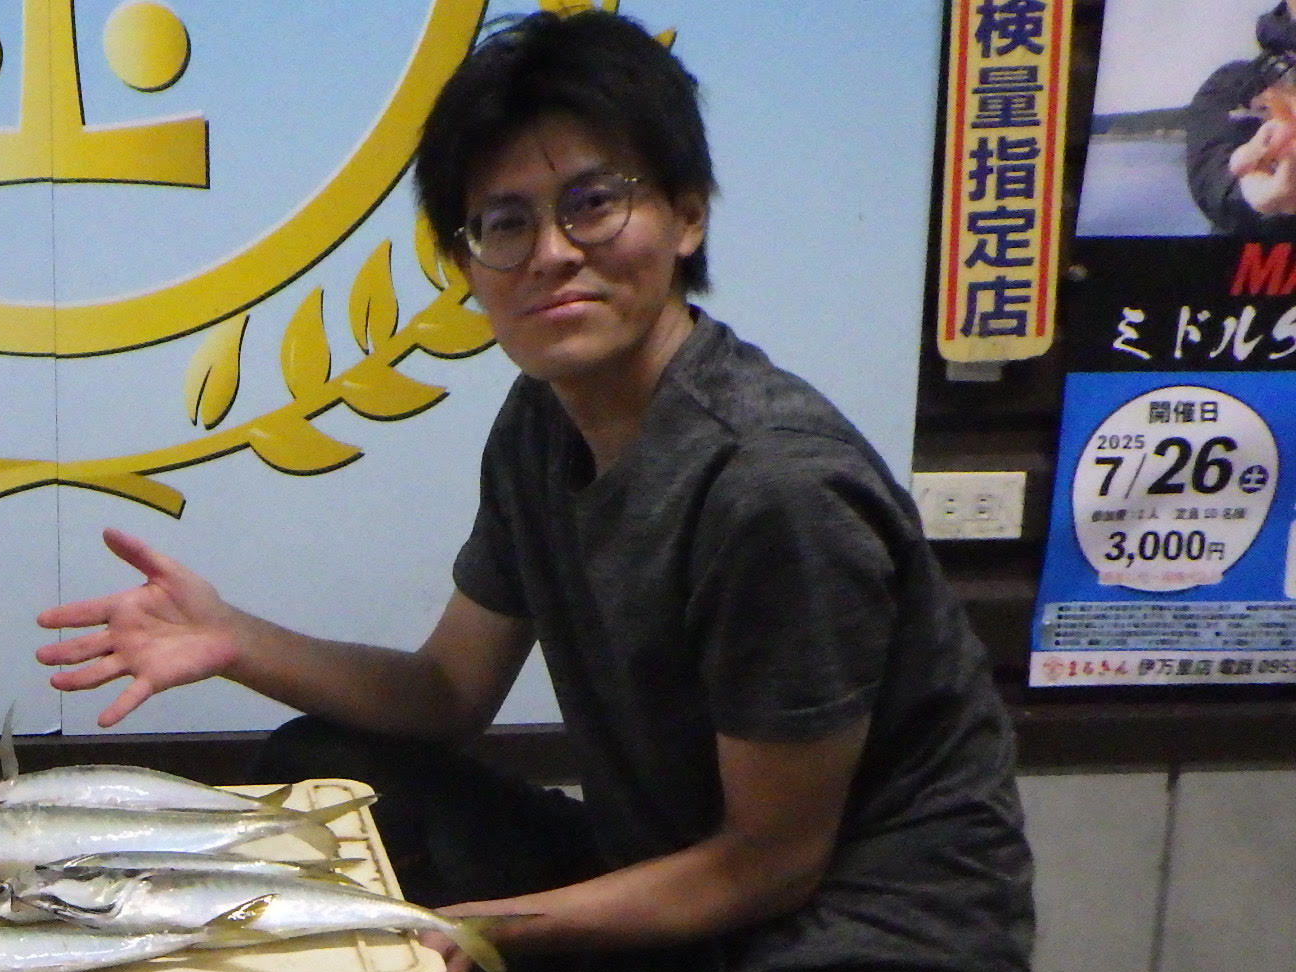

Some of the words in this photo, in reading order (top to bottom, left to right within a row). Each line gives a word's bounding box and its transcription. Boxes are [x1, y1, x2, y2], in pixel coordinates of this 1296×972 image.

[960, 0, 1047, 338] 検量指定店
[1229, 242, 1296, 296] M
[1148, 400, 1219, 425] 開催日
[1096, 434, 1145, 450] 2025
[1104, 529, 1226, 568] 3,000円
